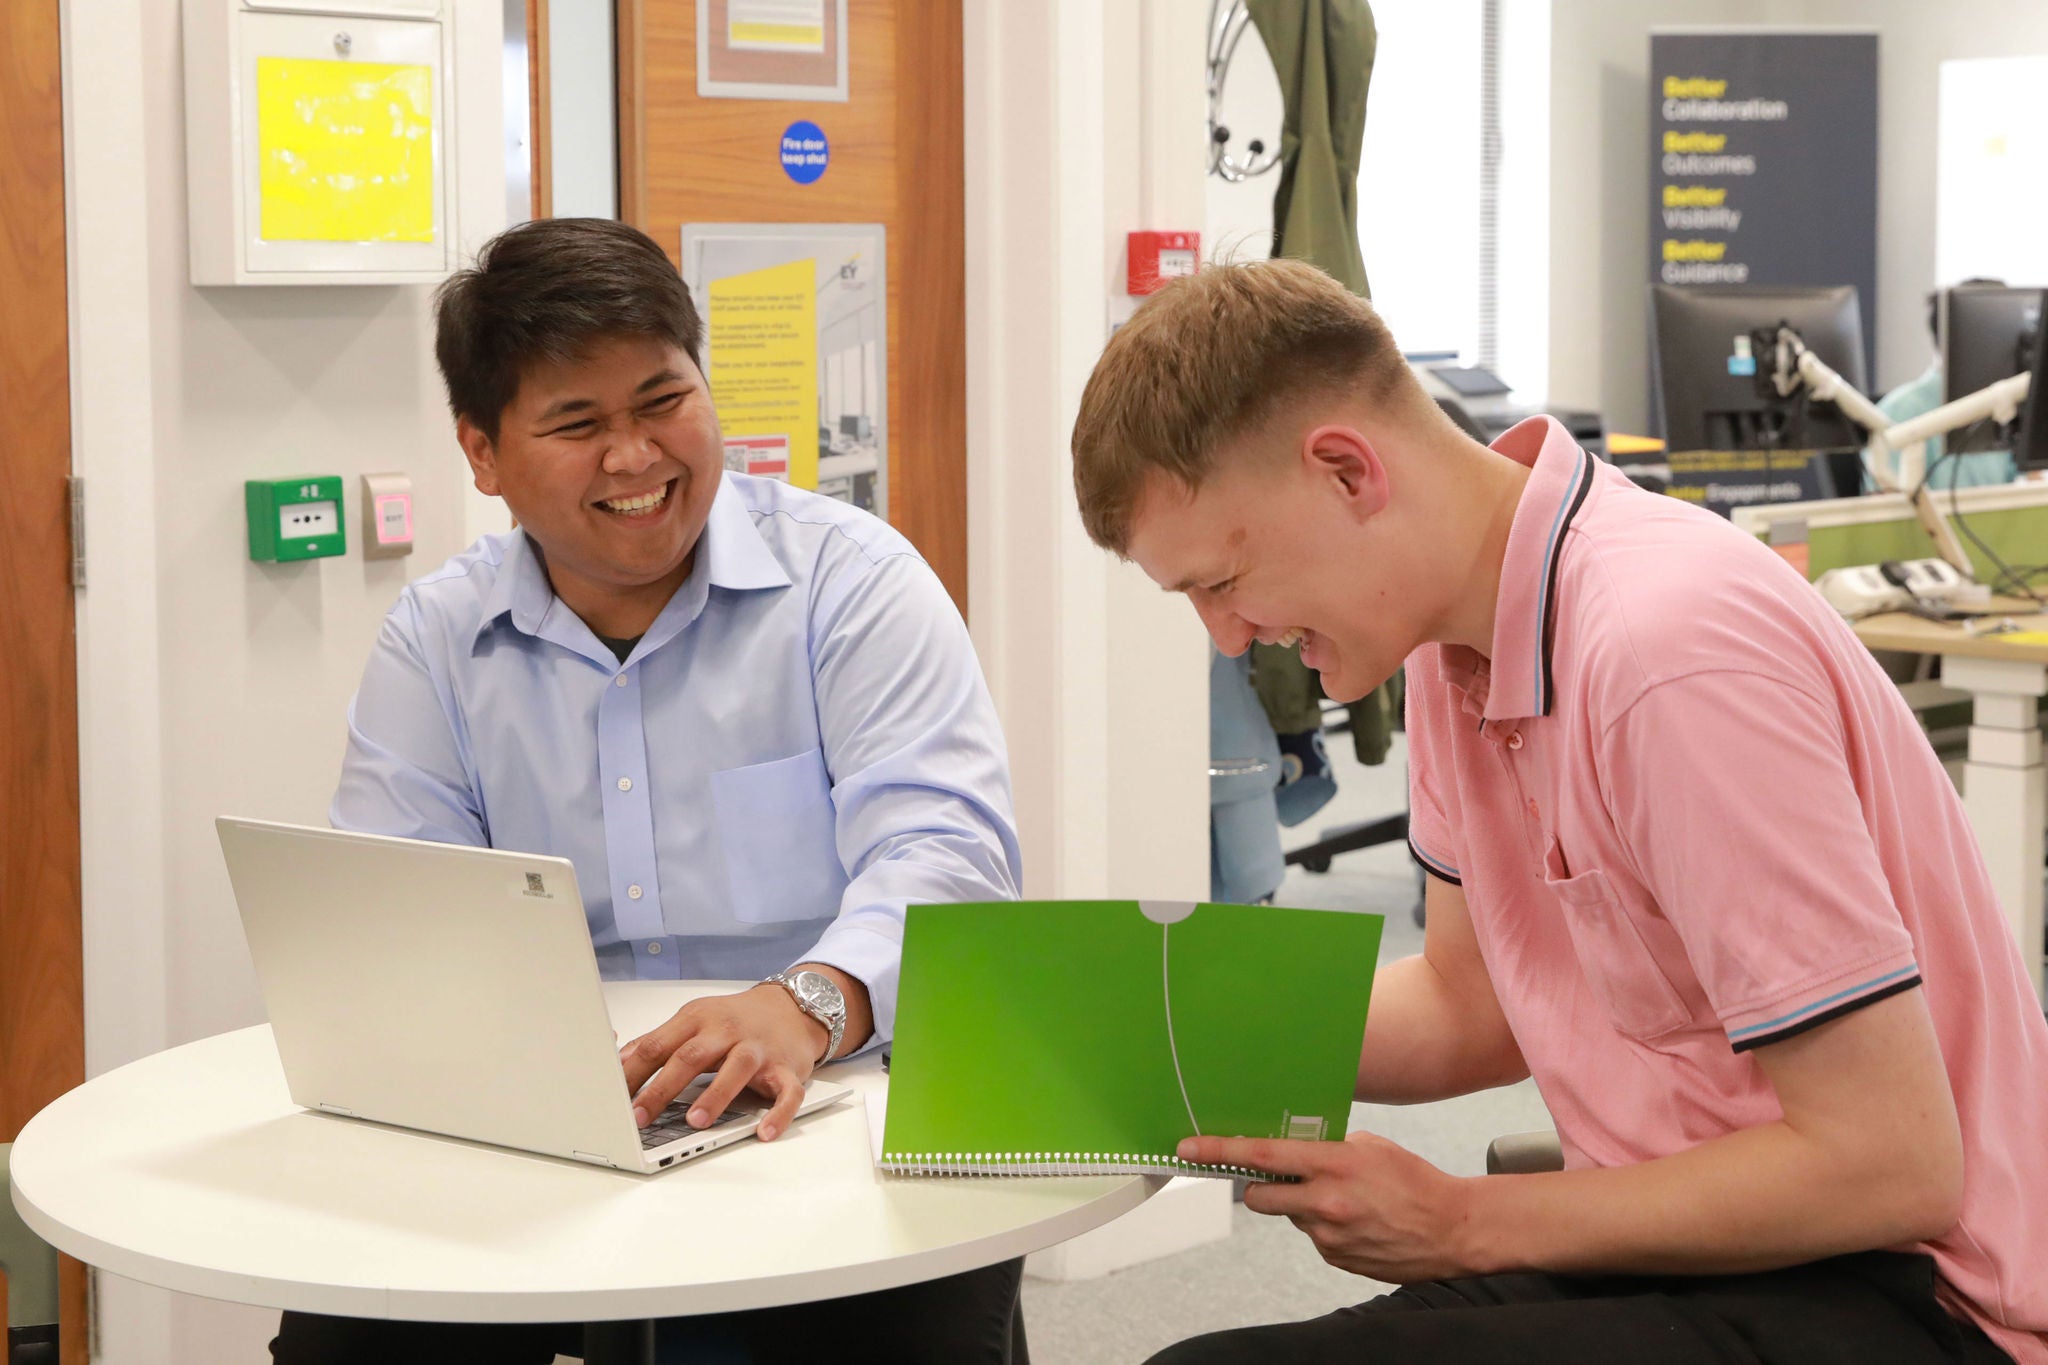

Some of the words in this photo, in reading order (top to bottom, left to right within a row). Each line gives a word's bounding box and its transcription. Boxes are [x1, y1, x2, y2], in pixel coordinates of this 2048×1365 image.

[1663, 76, 1727, 98] Better
[1662, 97, 1788, 121] Collaboration
[783, 137, 801, 150] Fire
[803, 137, 825, 150] door
[1663, 130, 1727, 153] Better
[782, 152, 805, 167] keep
[806, 152, 827, 165] shut
[1662, 152, 1757, 176] Outcomes
[1663, 185, 1727, 207] Better
[1662, 206, 1742, 232] Visibility
[1663, 239, 1727, 262] Better
[841, 264, 858, 279] EY
[1661, 261, 1749, 284] Guidance
